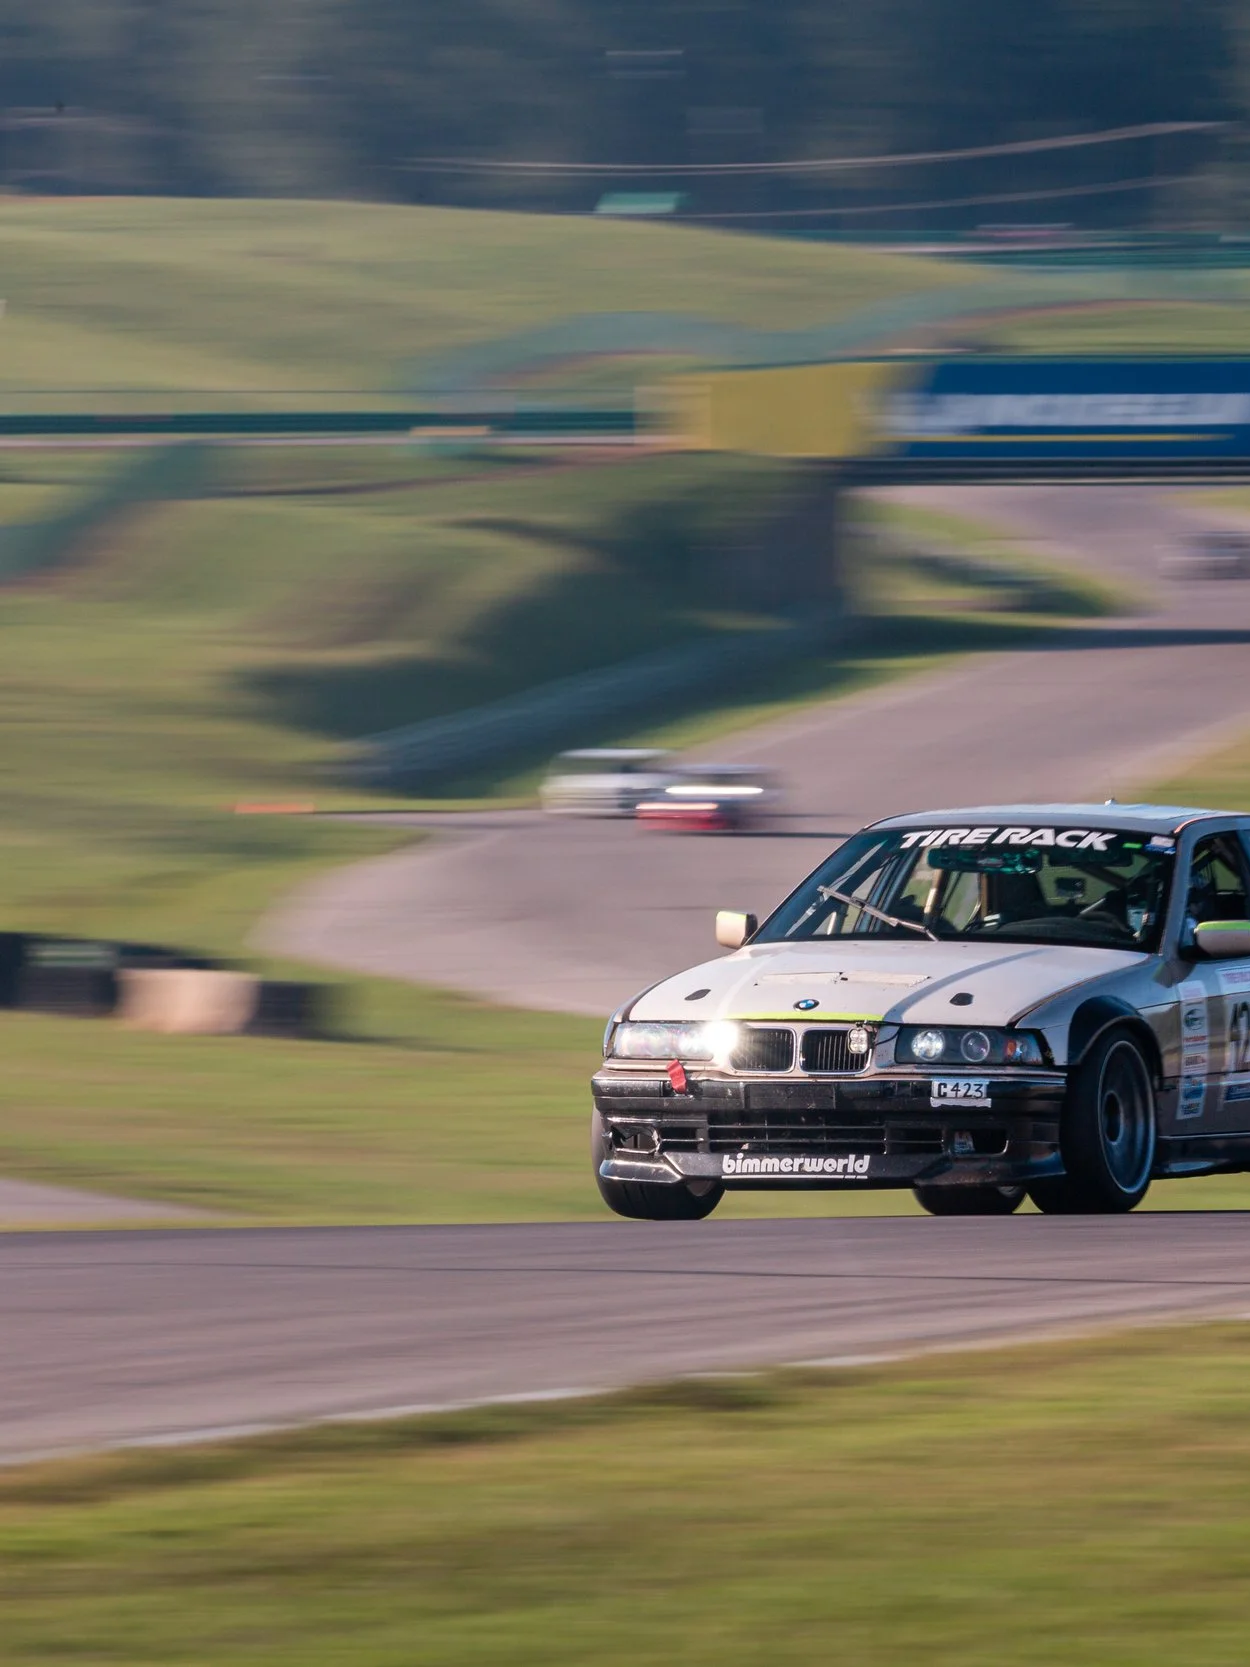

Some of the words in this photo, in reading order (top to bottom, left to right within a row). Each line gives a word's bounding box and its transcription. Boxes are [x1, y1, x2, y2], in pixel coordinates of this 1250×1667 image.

[901, 828, 994, 848] TIRE
[994, 828, 1117, 850] RACK
[938, 1083, 948, 1098] C
[951, 1082, 984, 1099] 423
[722, 1153, 870, 1174] bimmerworld
